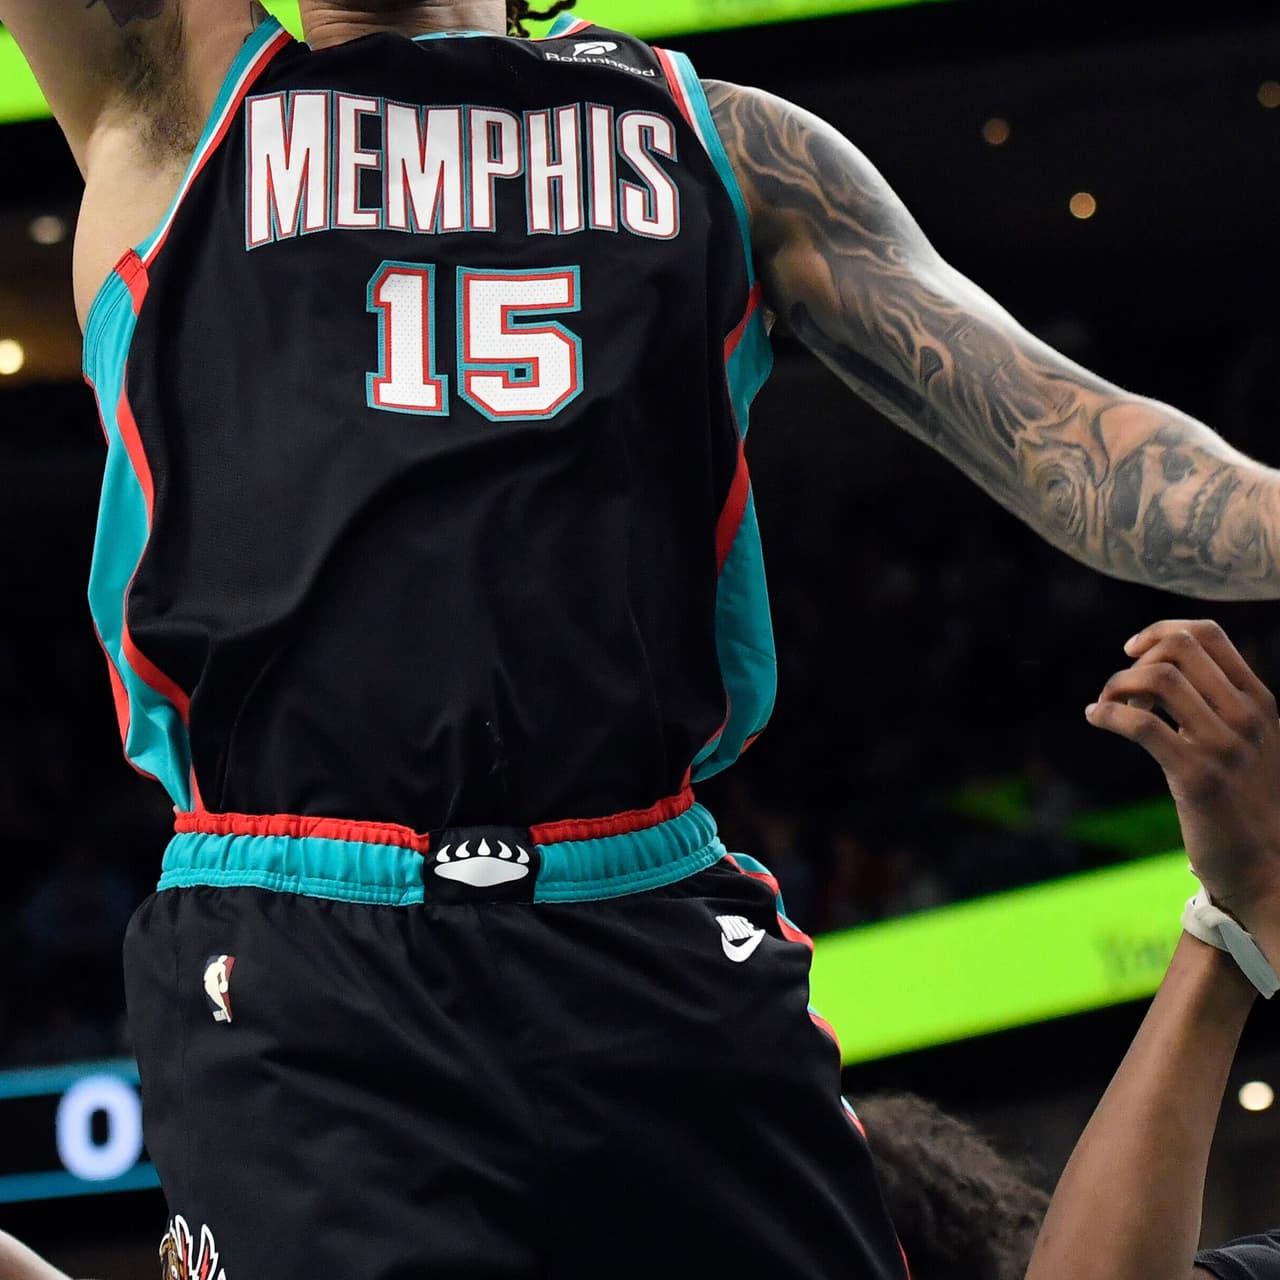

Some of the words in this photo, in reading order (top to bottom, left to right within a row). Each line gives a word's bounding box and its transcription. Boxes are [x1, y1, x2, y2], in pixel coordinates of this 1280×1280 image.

[544, 51, 656, 78] Robinhood
[245, 88, 680, 252] MEMPHIS
[366, 259, 584, 422] 15
[56, 1074, 143, 1181] 0
